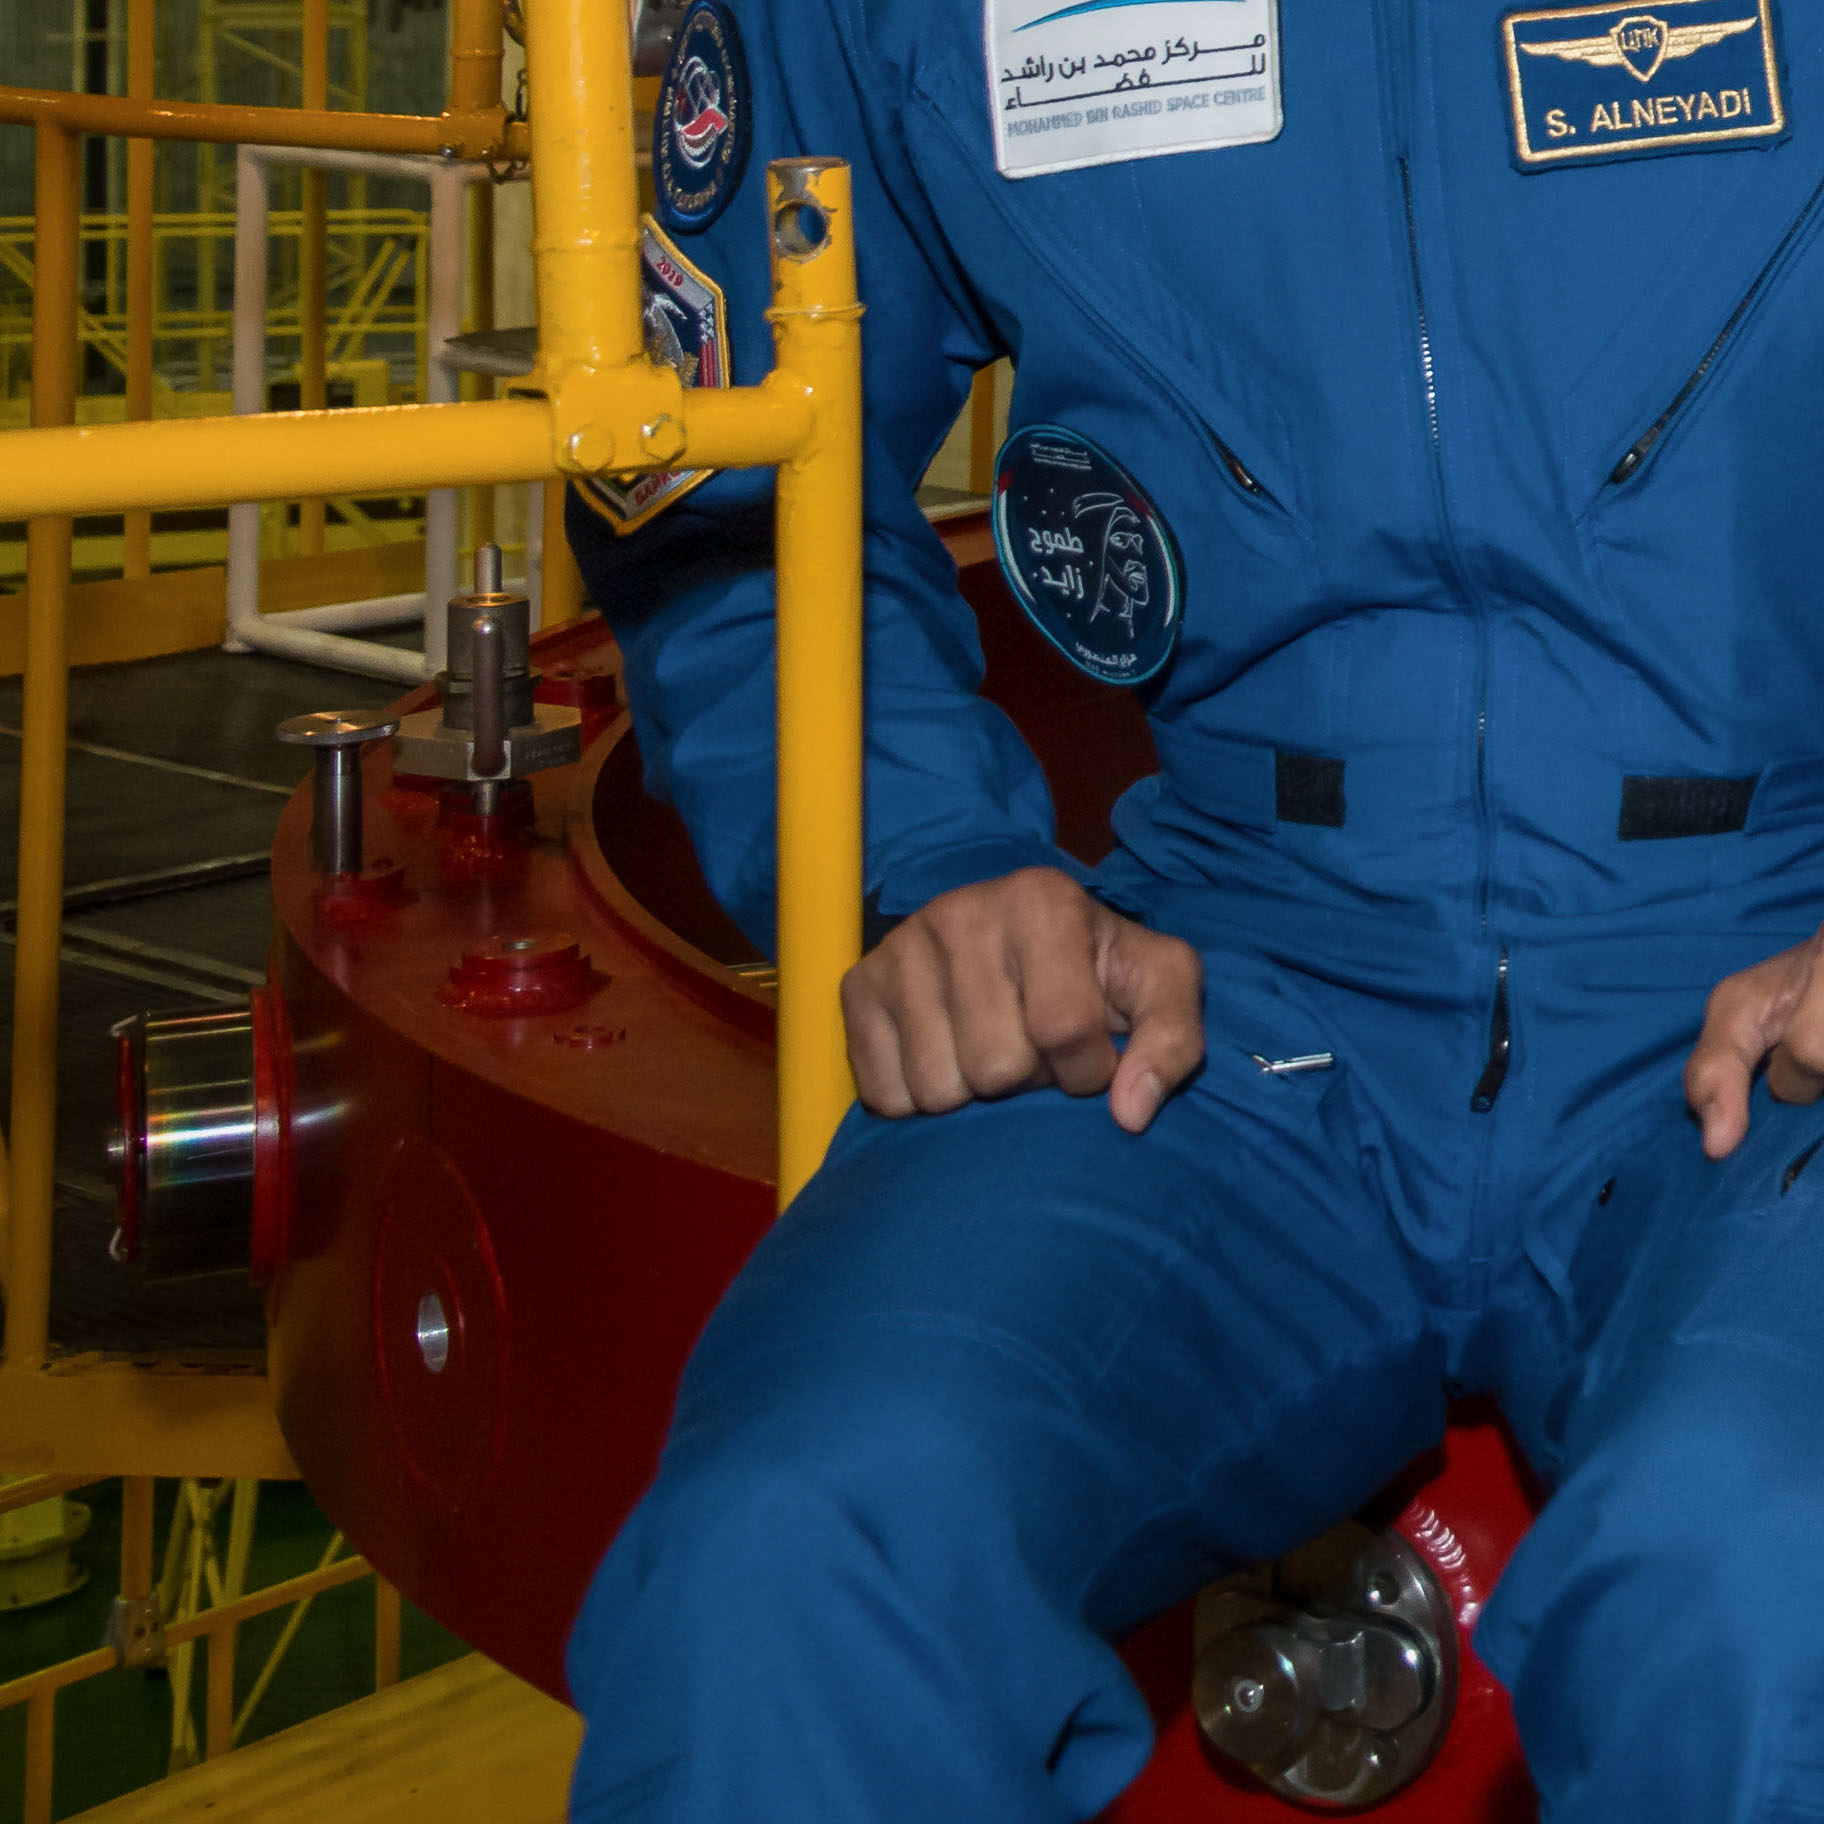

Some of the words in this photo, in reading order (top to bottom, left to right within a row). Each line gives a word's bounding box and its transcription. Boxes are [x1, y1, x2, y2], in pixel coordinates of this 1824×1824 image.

[1093, 45, 1157, 69] محمد
[1161, 33, 1266, 66] مركز
[1001, 55, 1055, 83] راشد
[1058, 56, 1087, 80] بن
[1007, 112, 1083, 137] MOHAMMED
[1086, 106, 1109, 126] BIN
[1112, 98, 1162, 120] RASHID
[1167, 90, 1210, 112] SPACE
[1213, 85, 1266, 106] CENTRE
[1545, 109, 1577, 137] S.
[1590, 87, 1752, 133] ALNEYADI
